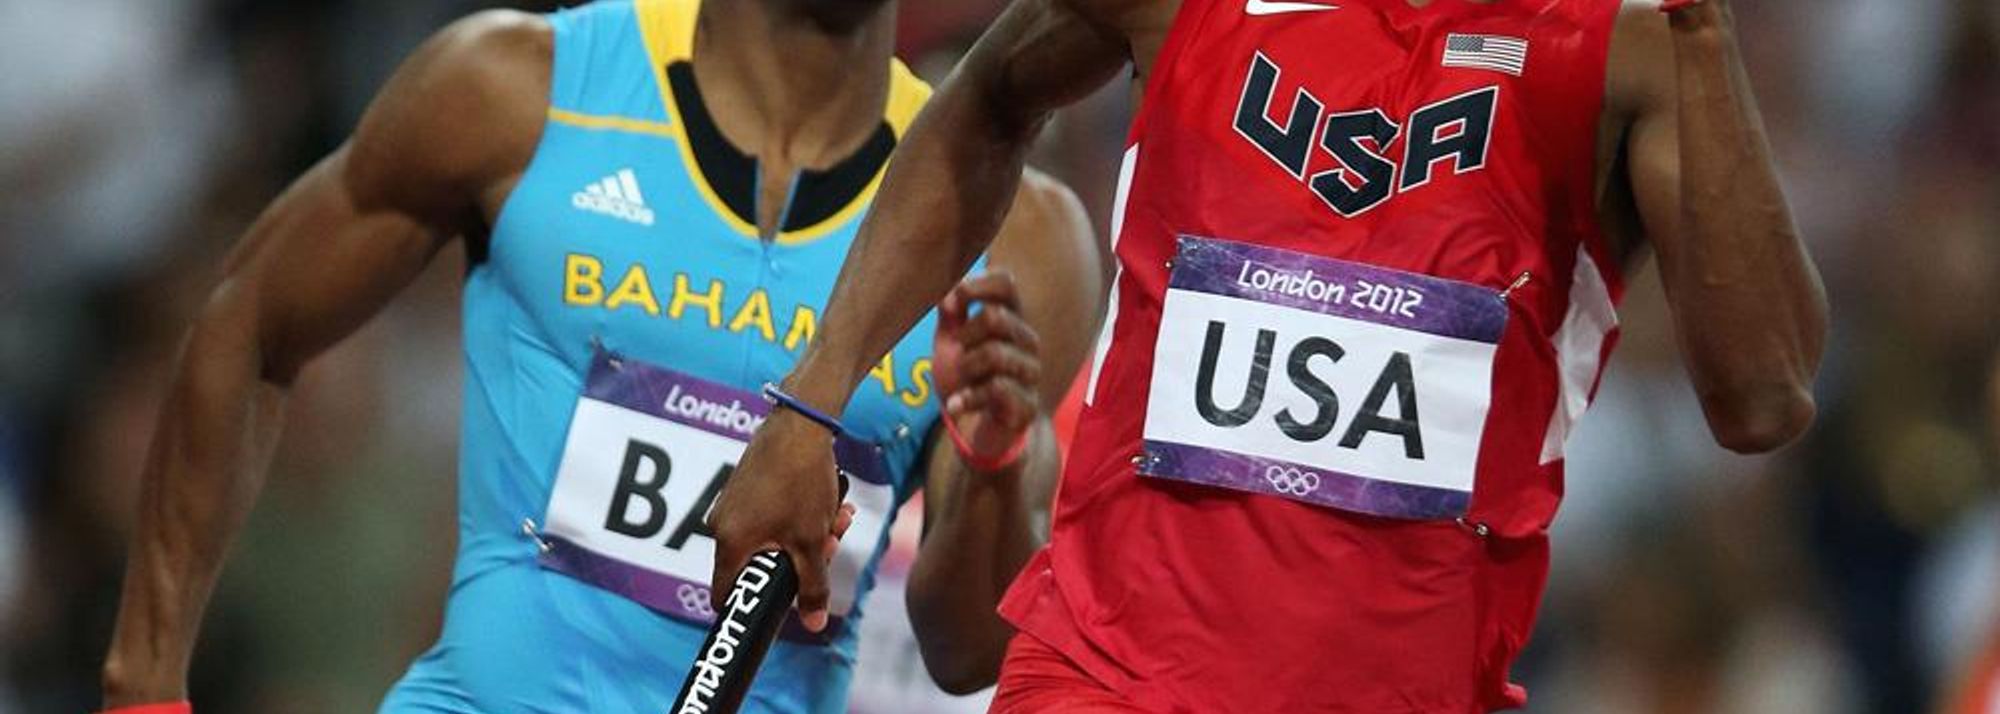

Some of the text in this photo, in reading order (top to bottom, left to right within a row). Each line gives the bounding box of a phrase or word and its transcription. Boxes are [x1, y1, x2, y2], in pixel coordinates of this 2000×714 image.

[1233, 49, 1500, 218] USA
[1237, 259, 1424, 319] London 2012
[1194, 320, 1426, 461] USA
[603, 437, 736, 552] BA
[725, 551, 779, 615] 201
